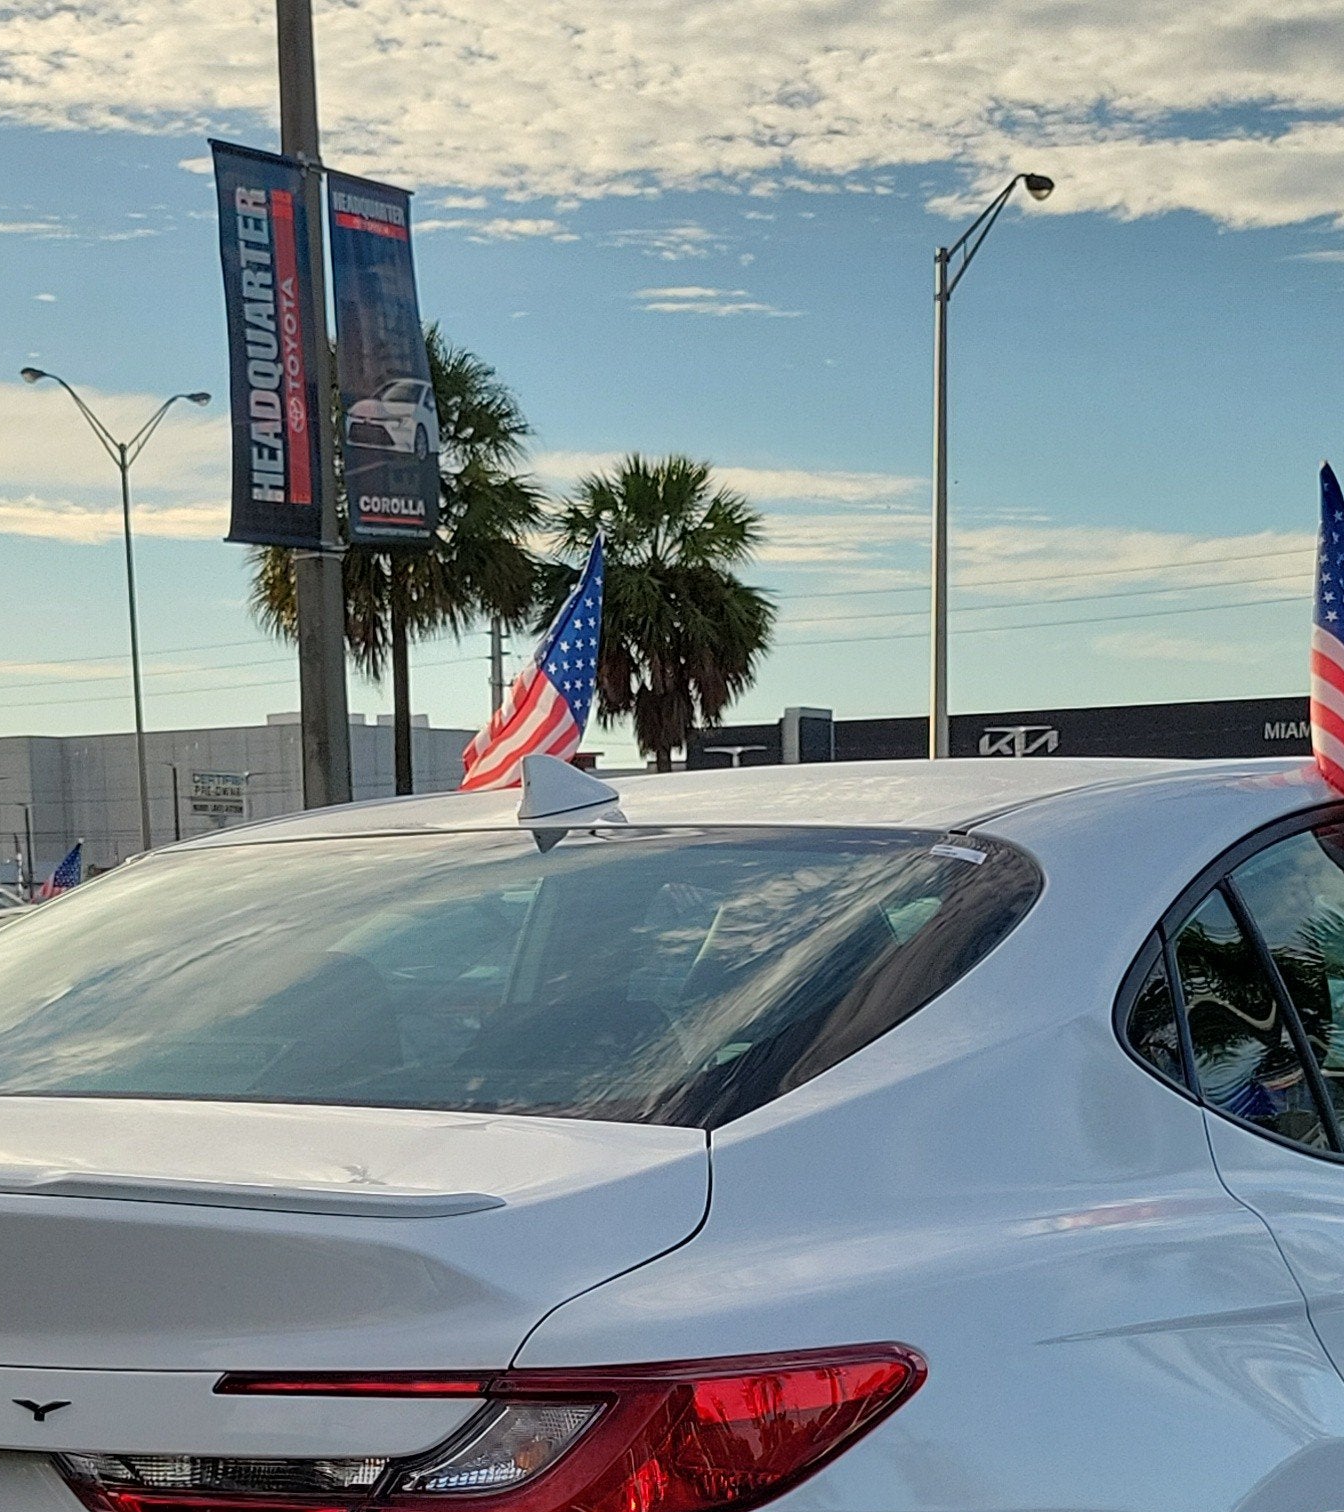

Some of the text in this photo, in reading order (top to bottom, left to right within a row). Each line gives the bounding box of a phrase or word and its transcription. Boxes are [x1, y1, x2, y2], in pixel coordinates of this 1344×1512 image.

[235, 186, 285, 503] HEADQUARTER
[280, 277, 302, 392] TOYOTA
[359, 495, 425, 516] COROLLA
[1264, 721, 1312, 739] MIAM
